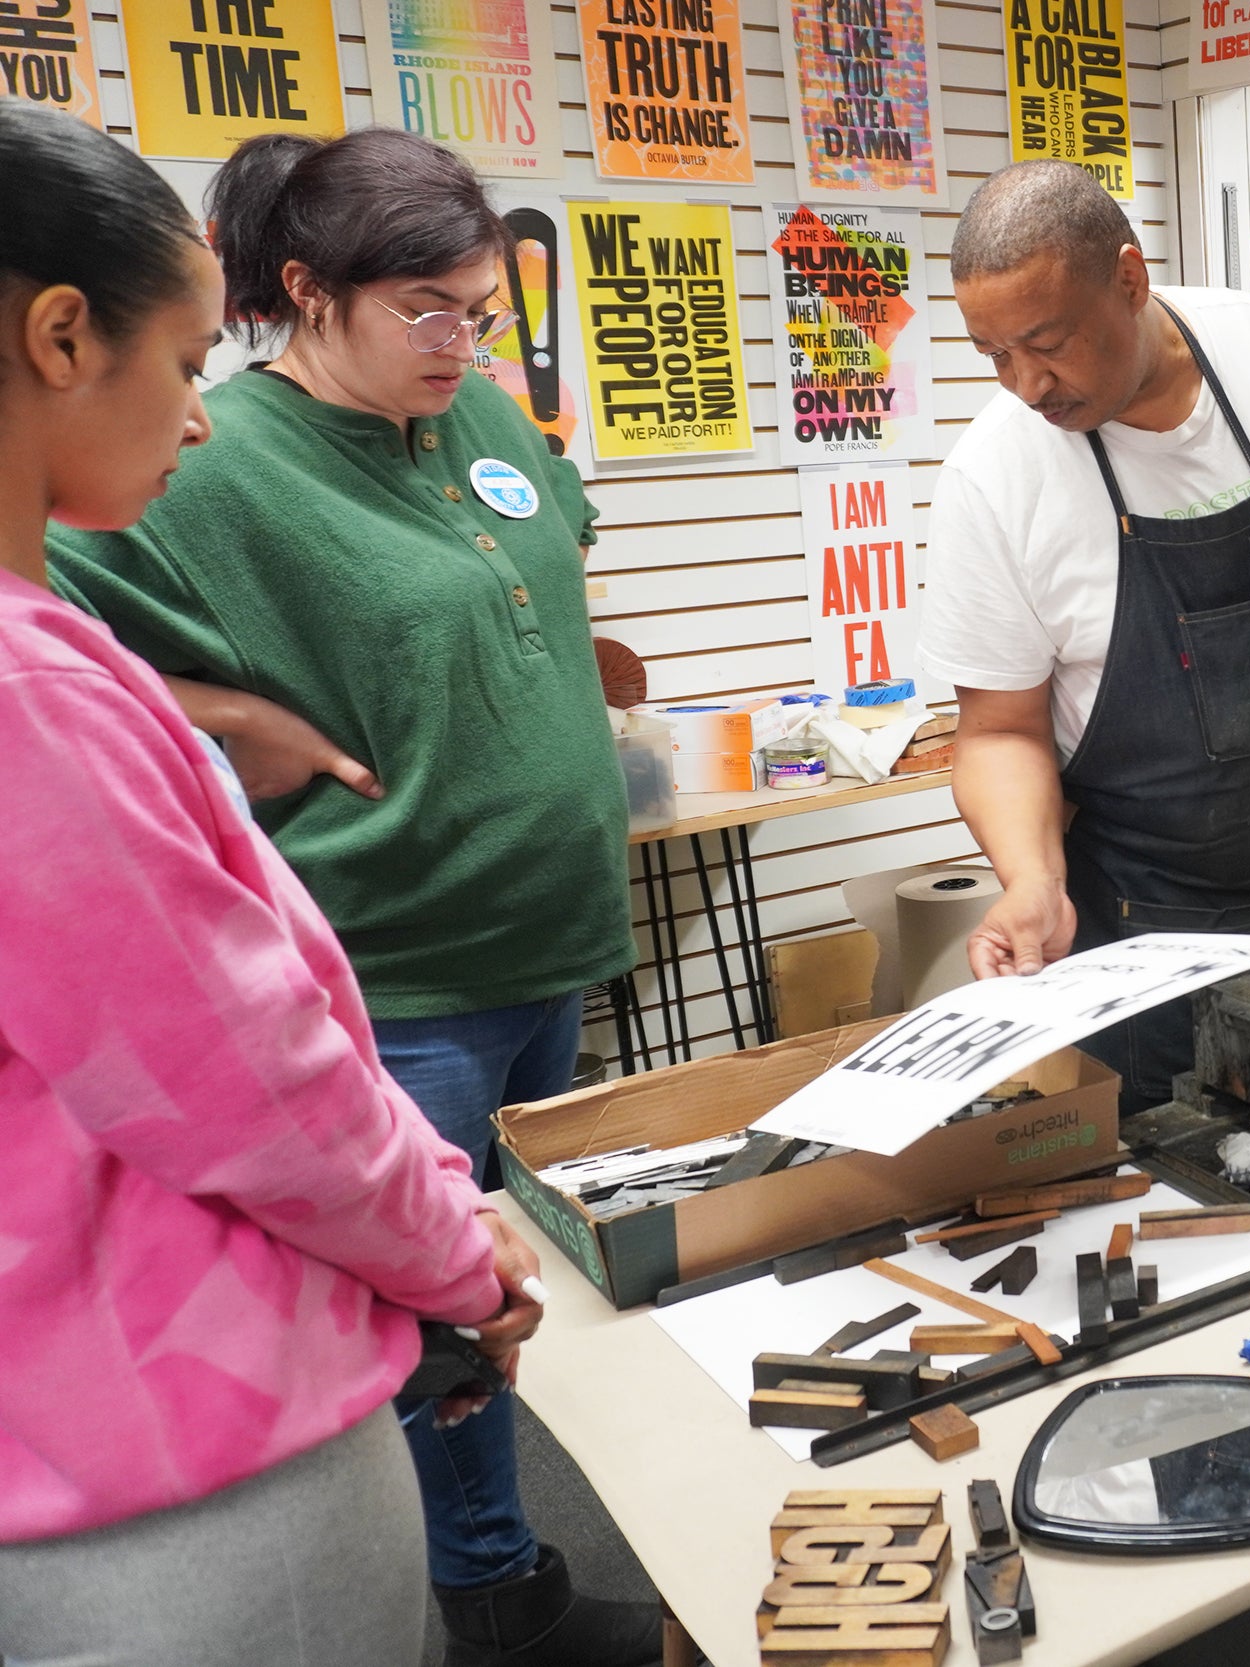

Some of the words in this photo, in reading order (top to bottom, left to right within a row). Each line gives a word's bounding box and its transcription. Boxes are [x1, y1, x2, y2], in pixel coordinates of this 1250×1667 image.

[606, 0, 714, 33] LASTING
[1011, 0, 1031, 30] A
[1041, 0, 1116, 40] CALL
[0, 52, 71, 102] YOU
[169, 41, 307, 120] TIME
[393, 54, 461, 70] RHODE
[464, 61, 532, 76] ISLAND
[597, 30, 731, 103] TRUTH
[837, 58, 884, 97] YOU
[1015, 32, 1076, 91] FOR
[398, 70, 535, 145] BLOWS
[883, 100, 896, 130] A
[1049, 91, 1060, 125] WHO
[1078, 42, 1127, 157] BLACK
[604, 101, 630, 142] IS
[634, 104, 739, 149] CHANGE.
[1021, 95, 1046, 150] HEAR
[1064, 94, 1075, 158] LEADERS
[512, 157, 536, 167] NOW
[647, 152, 679, 164] OCTAVIA
[681, 154, 707, 166] BUTLER
[822, 127, 912, 161] DAMN
[1050, 128, 1061, 157] CAN
[778, 212, 814, 225] HUMAN
[821, 213, 867, 226] DIGNITY
[780, 230, 790, 241] IS
[794, 230, 818, 242] THE
[823, 230, 852, 242] SAME
[857, 231, 881, 243] FOR
[886, 232, 905, 243] ALL
[580, 213, 645, 276] WE
[648, 237, 721, 276] WANT
[782, 246, 907, 271] HUMAN
[784, 273, 909, 297] BEINGS:
[652, 278, 688, 348] FOR
[587, 278, 665, 427] PEOPLE
[686, 279, 737, 420] EDUCATION
[790, 352, 804, 367] OF
[813, 351, 870, 366] ANOTHER
[662, 352, 697, 423] OUR
[793, 389, 838, 414] ON
[845, 388, 895, 412] MY
[621, 426, 645, 440] WE
[647, 425, 680, 439] PAID
[683, 424, 712, 437] FOR
[715, 423, 732, 436] IT!
[794, 417, 882, 442] OWN!
[825, 443, 844, 451] POPE
[847, 442, 878, 450] FRANCIS
[829, 483, 839, 530] I
[845, 480, 887, 529] AM
[822, 541, 906, 617] ANTI
[844, 620, 891, 686] FA
[842, 1009, 1054, 1082] LEARN
